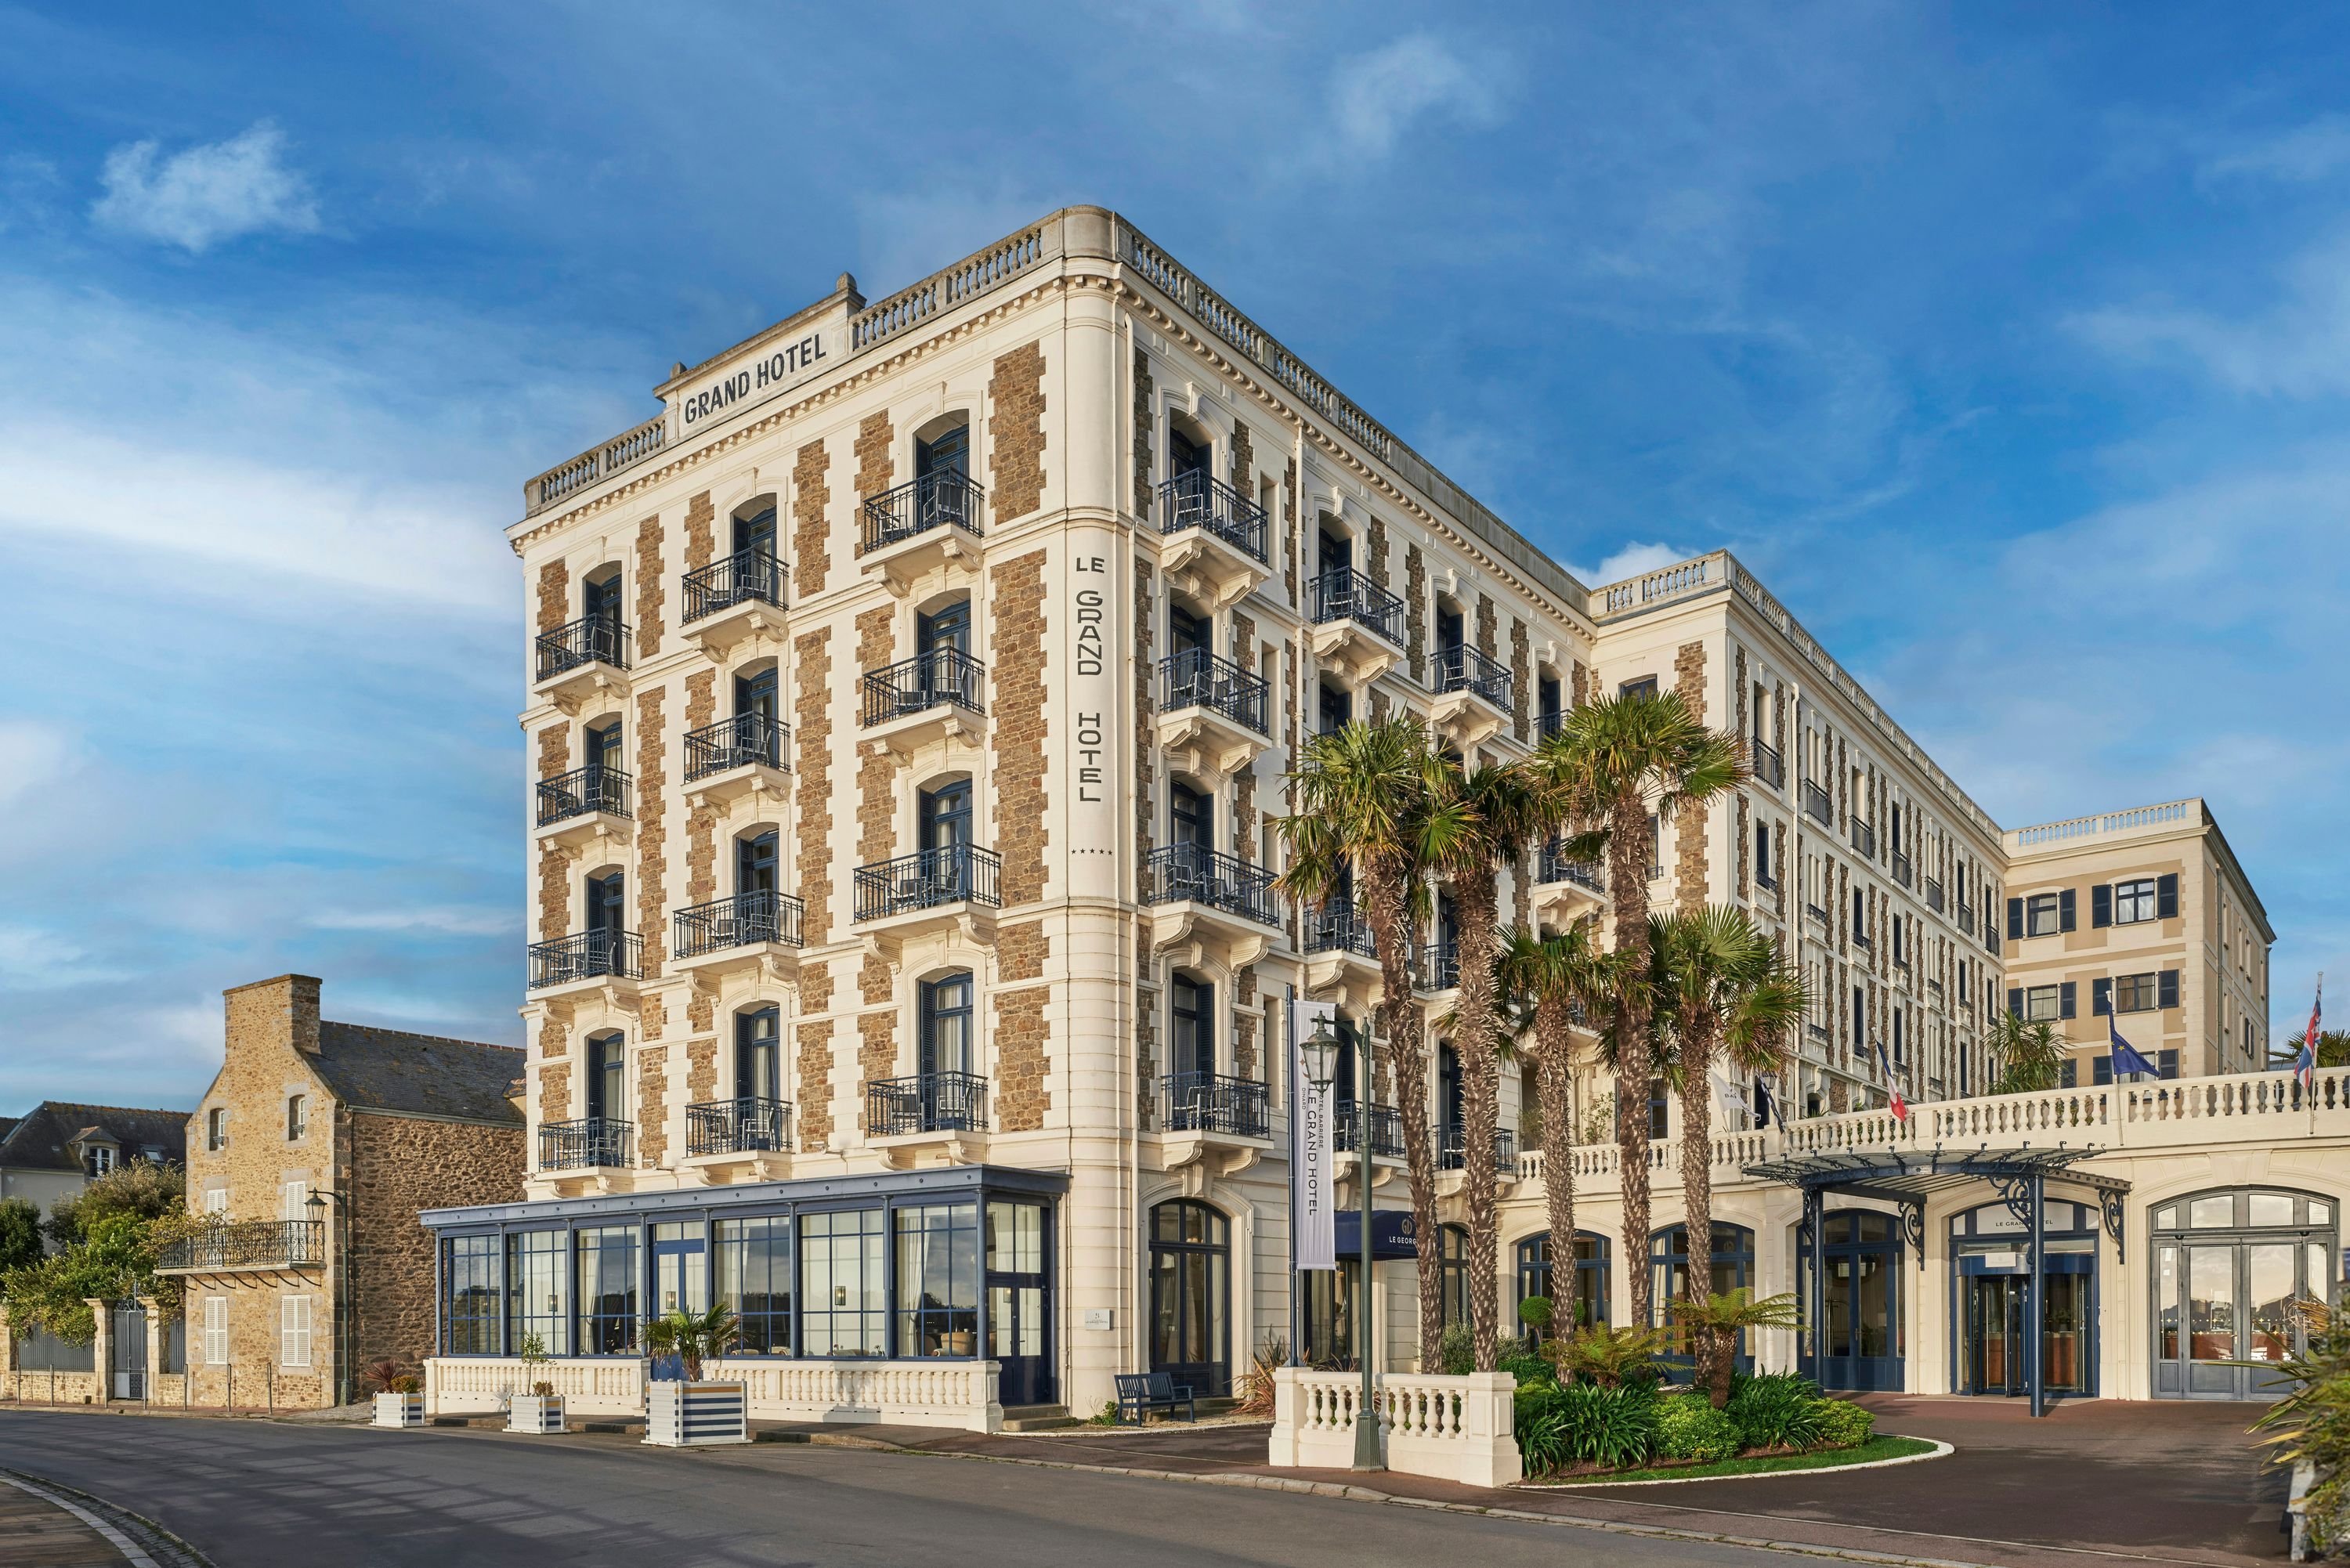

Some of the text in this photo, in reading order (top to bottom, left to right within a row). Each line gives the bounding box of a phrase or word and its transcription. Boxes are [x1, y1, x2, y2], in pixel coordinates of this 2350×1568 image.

[685, 334, 826, 424] GRAND HOTEL
[1076, 557, 1104, 802] LE GRAND HOTEL
[1307, 1088, 1317, 1104] LE
[1307, 1111, 1317, 1162] GRAND
